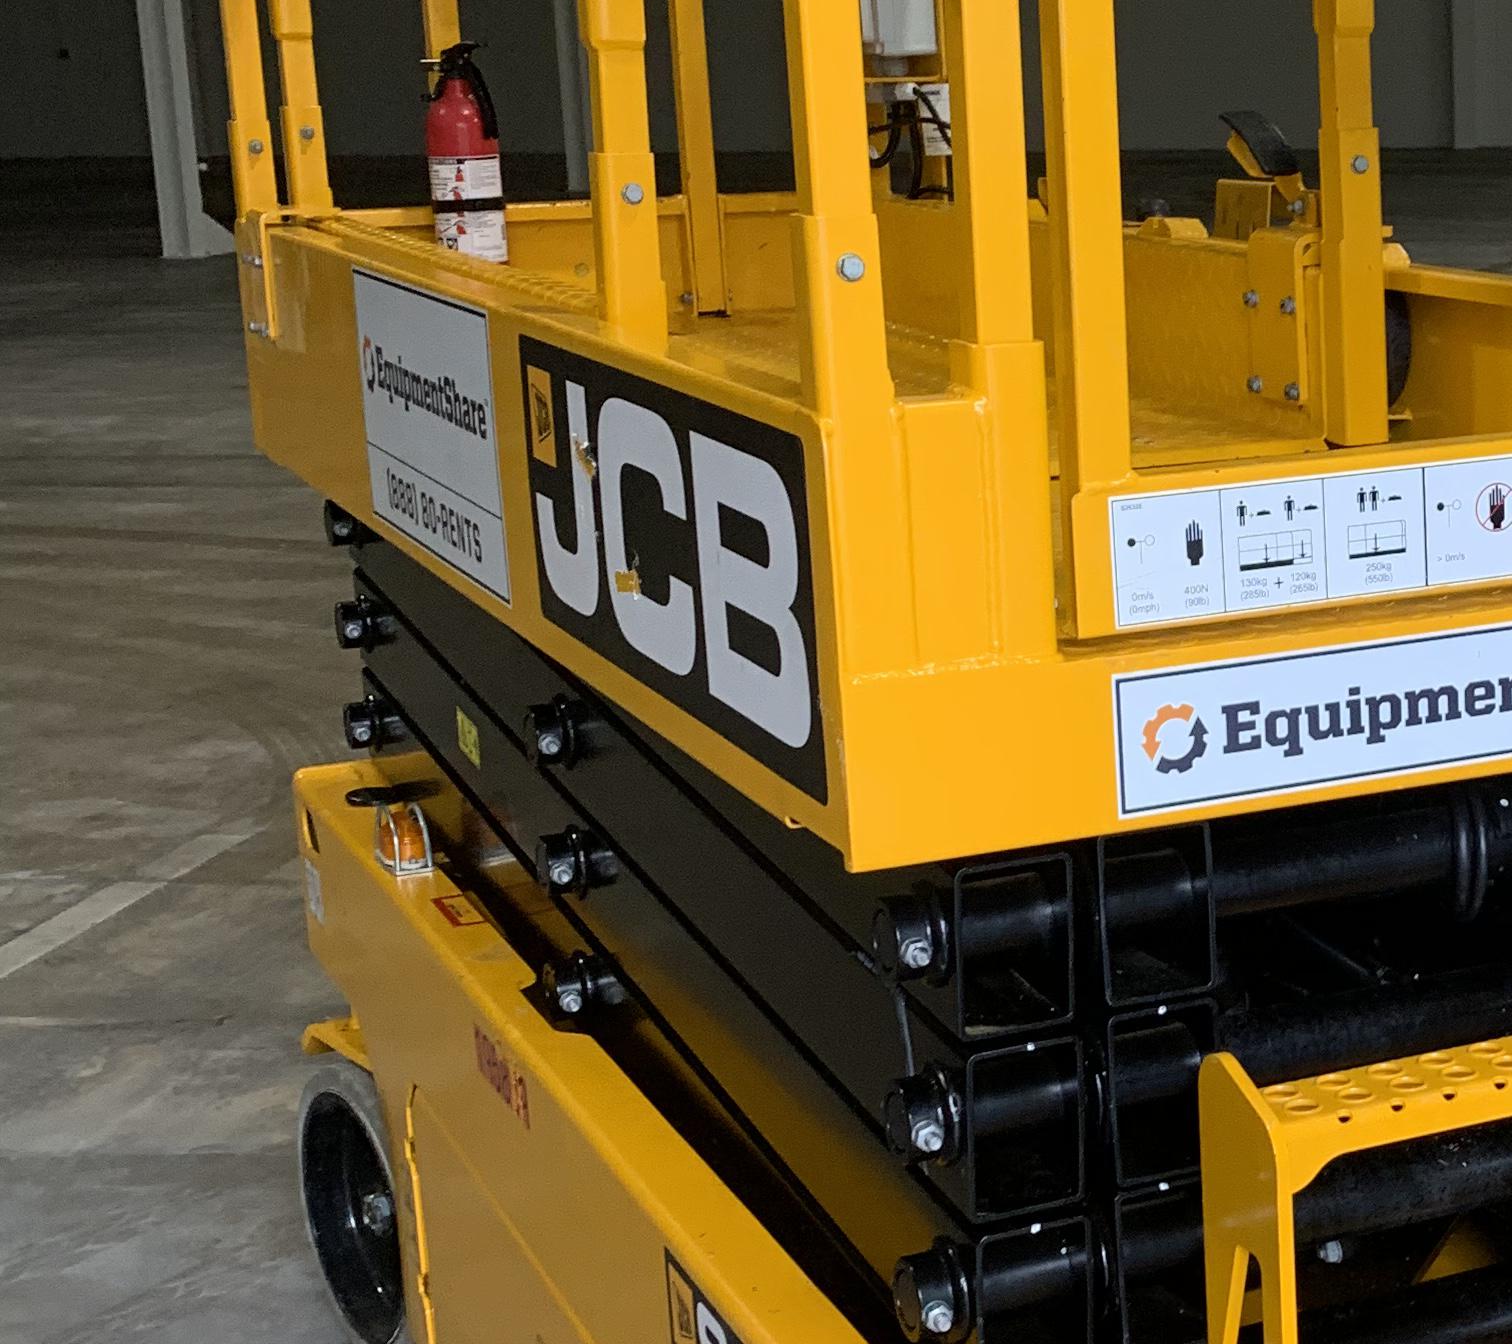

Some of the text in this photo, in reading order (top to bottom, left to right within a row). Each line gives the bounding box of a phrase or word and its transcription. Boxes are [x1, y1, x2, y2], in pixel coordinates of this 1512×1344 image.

[374, 345, 488, 440] EquipmentShare
[386, 466, 483, 563] (888) 80-RENTS
[535, 379, 812, 749] JCB
[1365, 562, 1392, 573] 250kg
